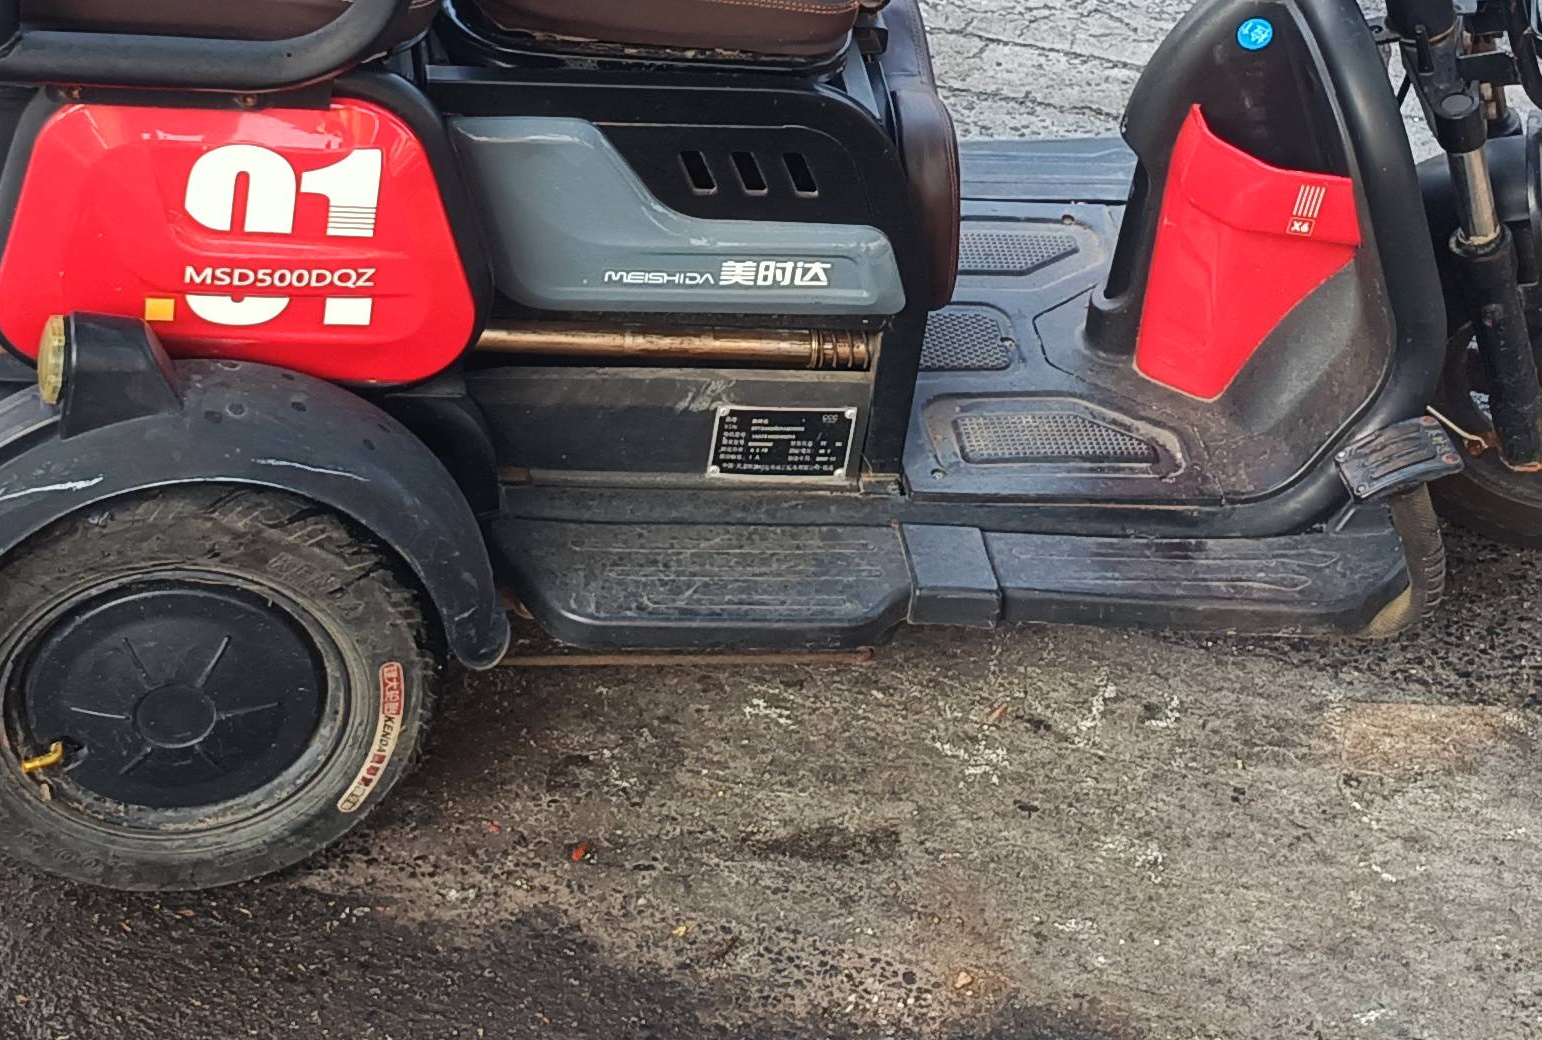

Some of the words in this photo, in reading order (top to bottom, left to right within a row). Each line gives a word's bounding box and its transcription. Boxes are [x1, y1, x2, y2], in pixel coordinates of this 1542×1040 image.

[1290, 220, 1310, 233] X6
[184, 265, 376, 288] MSD500DQZ
[604, 270, 715, 285] MEISHIDA
[719, 260, 833, 286] 美时达
[376, 715, 395, 753] KENDA
